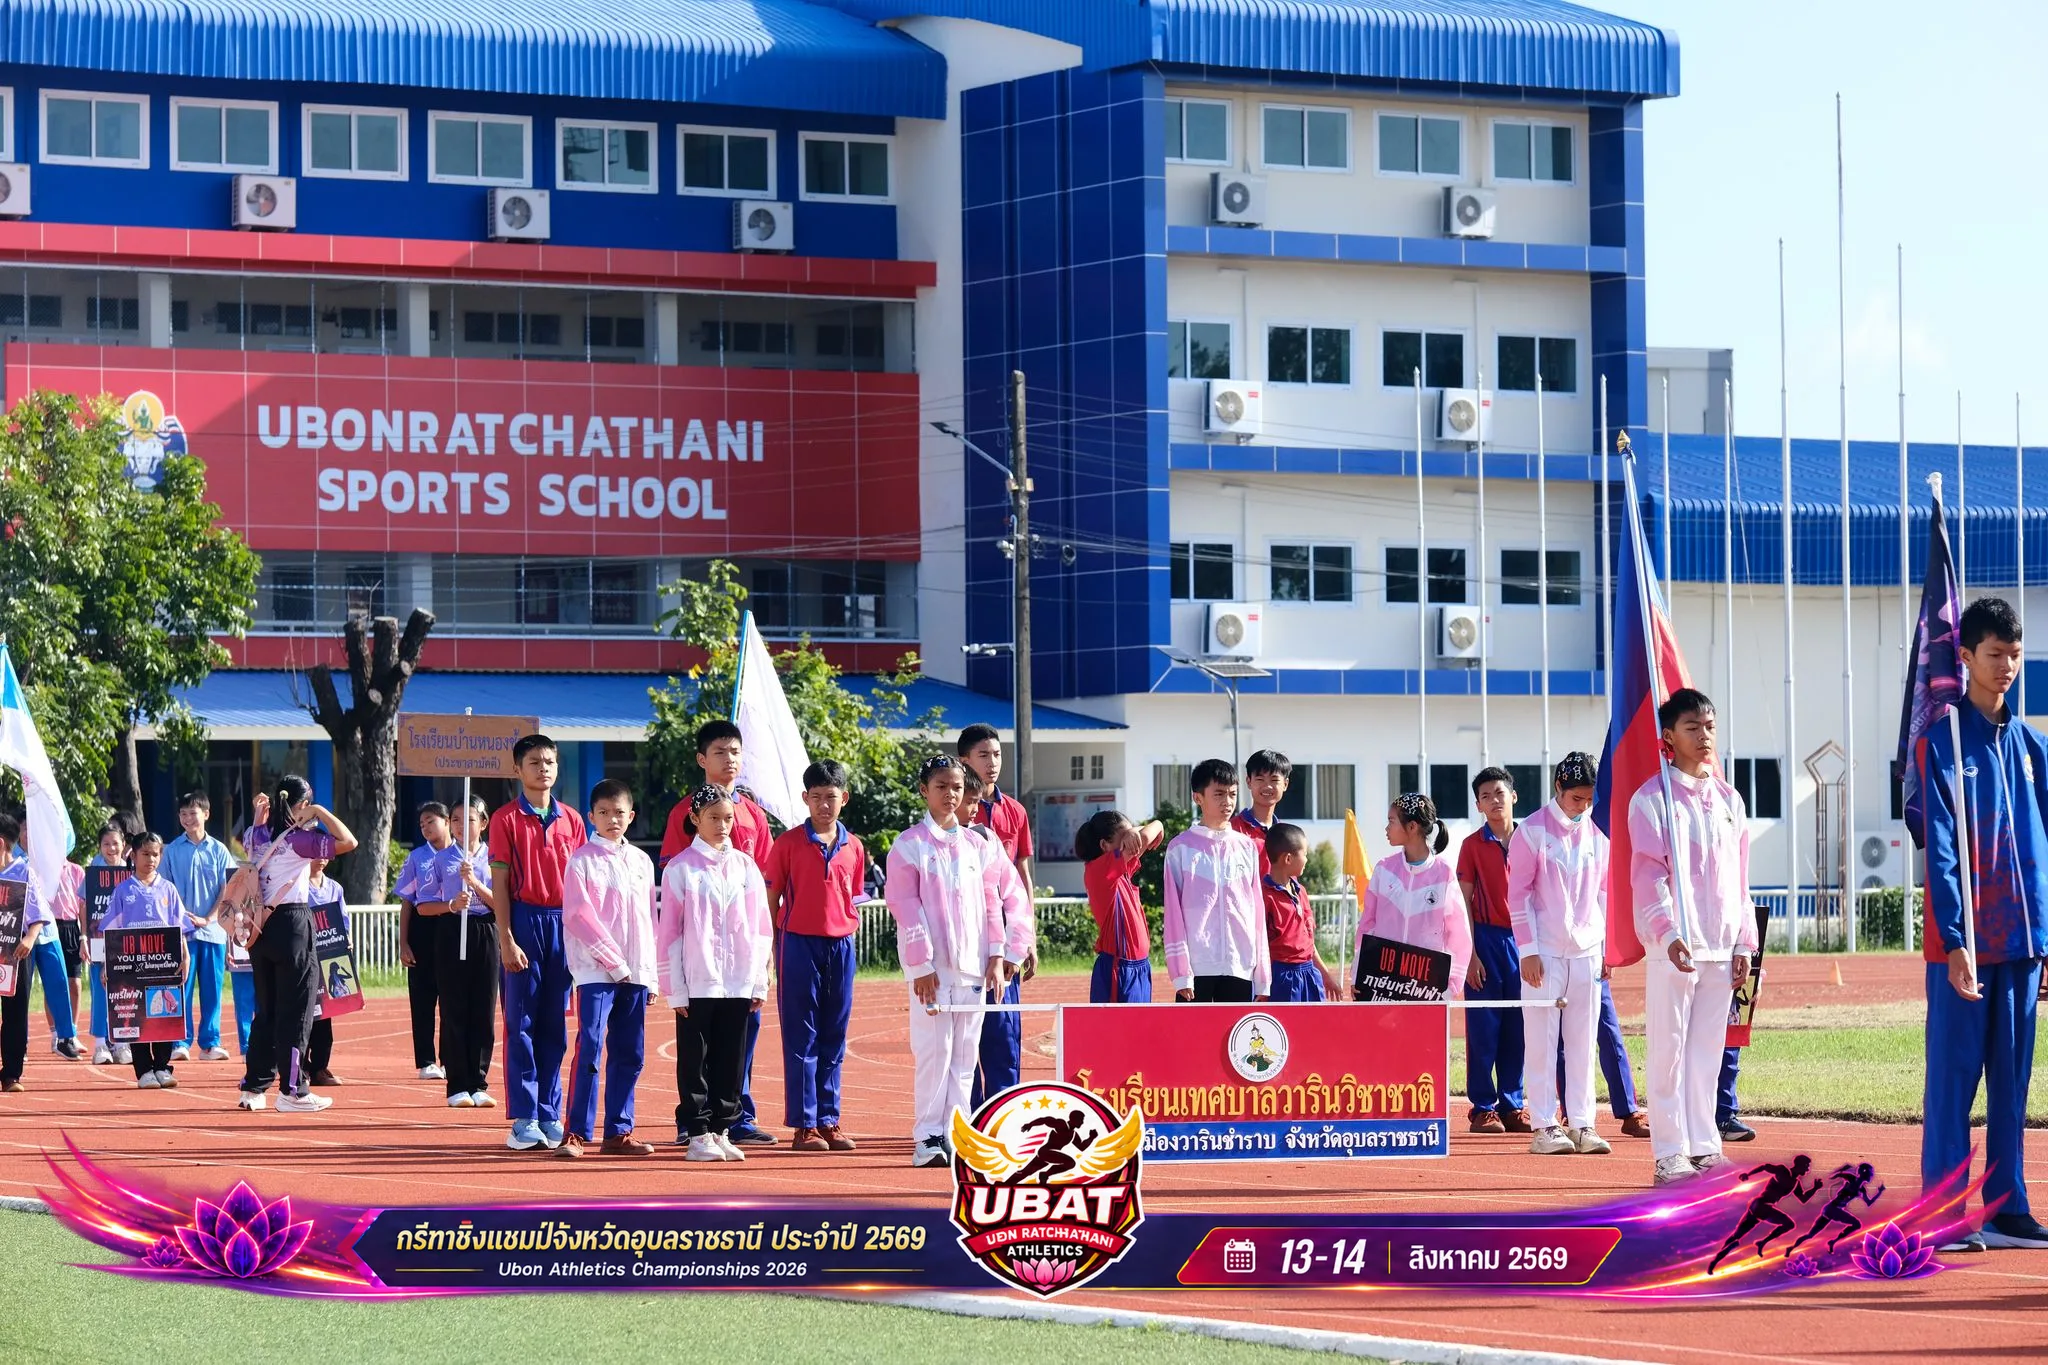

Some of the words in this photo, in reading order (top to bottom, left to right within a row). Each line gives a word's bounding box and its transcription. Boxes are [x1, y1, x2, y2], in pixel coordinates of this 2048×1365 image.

[258, 405, 764, 462] UBONRATCHATHANI
[318, 468, 510, 516] SPORTS
[539, 473, 728, 520] SCHOOL
[123, 935, 135, 954] UB
[140, 934, 166, 953] MOVE
[148, 953, 172, 961] MOVE
[1380, 946, 1396, 973] UB
[1400, 951, 1432, 982] MOVE
[1077, 1068, 1436, 1118] โงเรียนเทศบาลวารินวิชาชาติ
[1142, 1127, 1276, 1151] มืองวารินชำราบ
[1285, 1122, 1440, 1156] จังหวัดอุบลราชธานี
